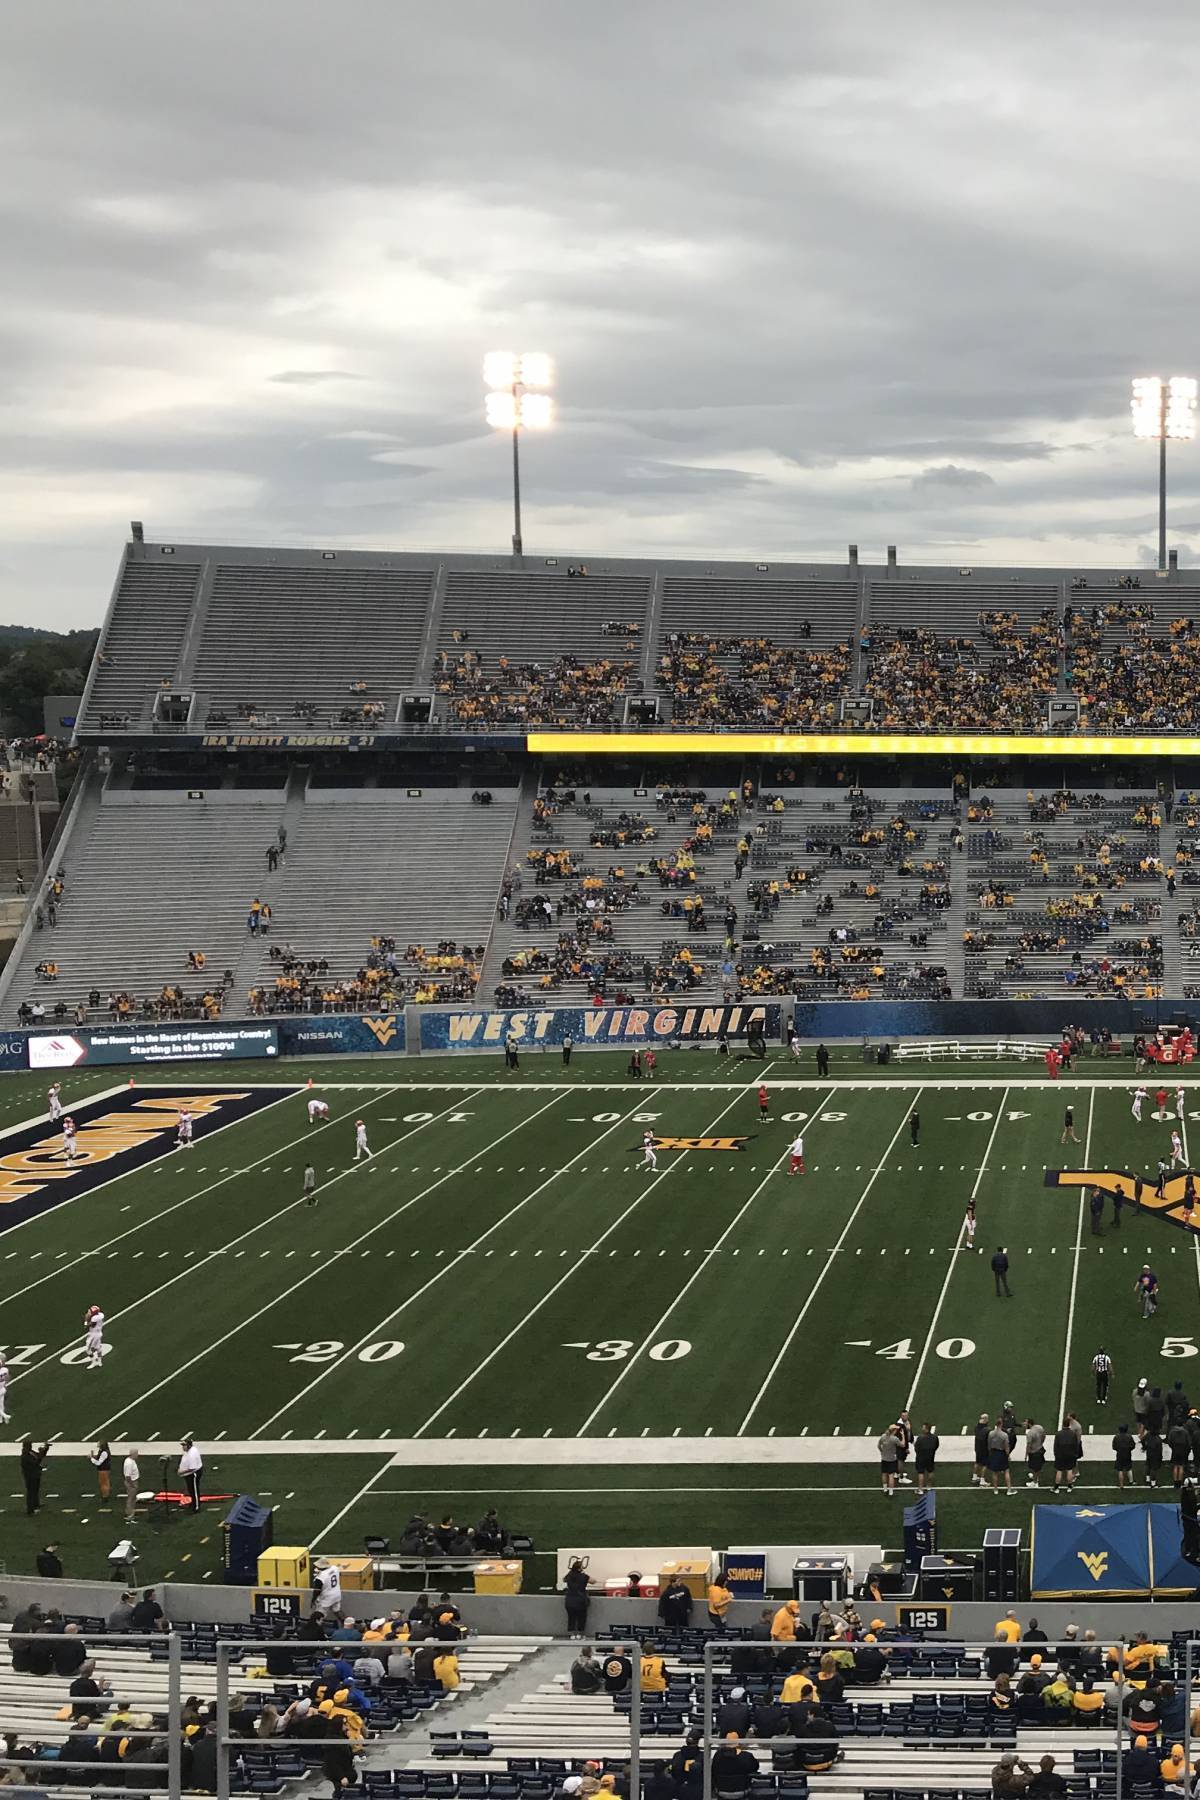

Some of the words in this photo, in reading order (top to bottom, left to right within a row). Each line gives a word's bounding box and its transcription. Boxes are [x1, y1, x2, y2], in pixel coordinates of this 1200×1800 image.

[450, 1013, 554, 1041] WEST
[585, 1007, 766, 1036] VIRGINIA
[136, 1034, 145, 1043] in
[145, 1034, 159, 1043] the
[160, 1033, 182, 1042] Heart
[182, 1033, 191, 1041] of
[239, 1029, 271, 1040] Country!
[297, 1031, 343, 1041] NISSAN
[130, 1044, 171, 1055] Starting
[172, 1044, 182, 1053] in
[183, 1043, 200, 1052] the
[289, 1340, 405, 1362] 20
[585, 1339, 692, 1362] 30
[875, 1337, 976, 1360] 40
[263, 1597, 292, 1615] 124
[909, 1611, 938, 1628] 125
